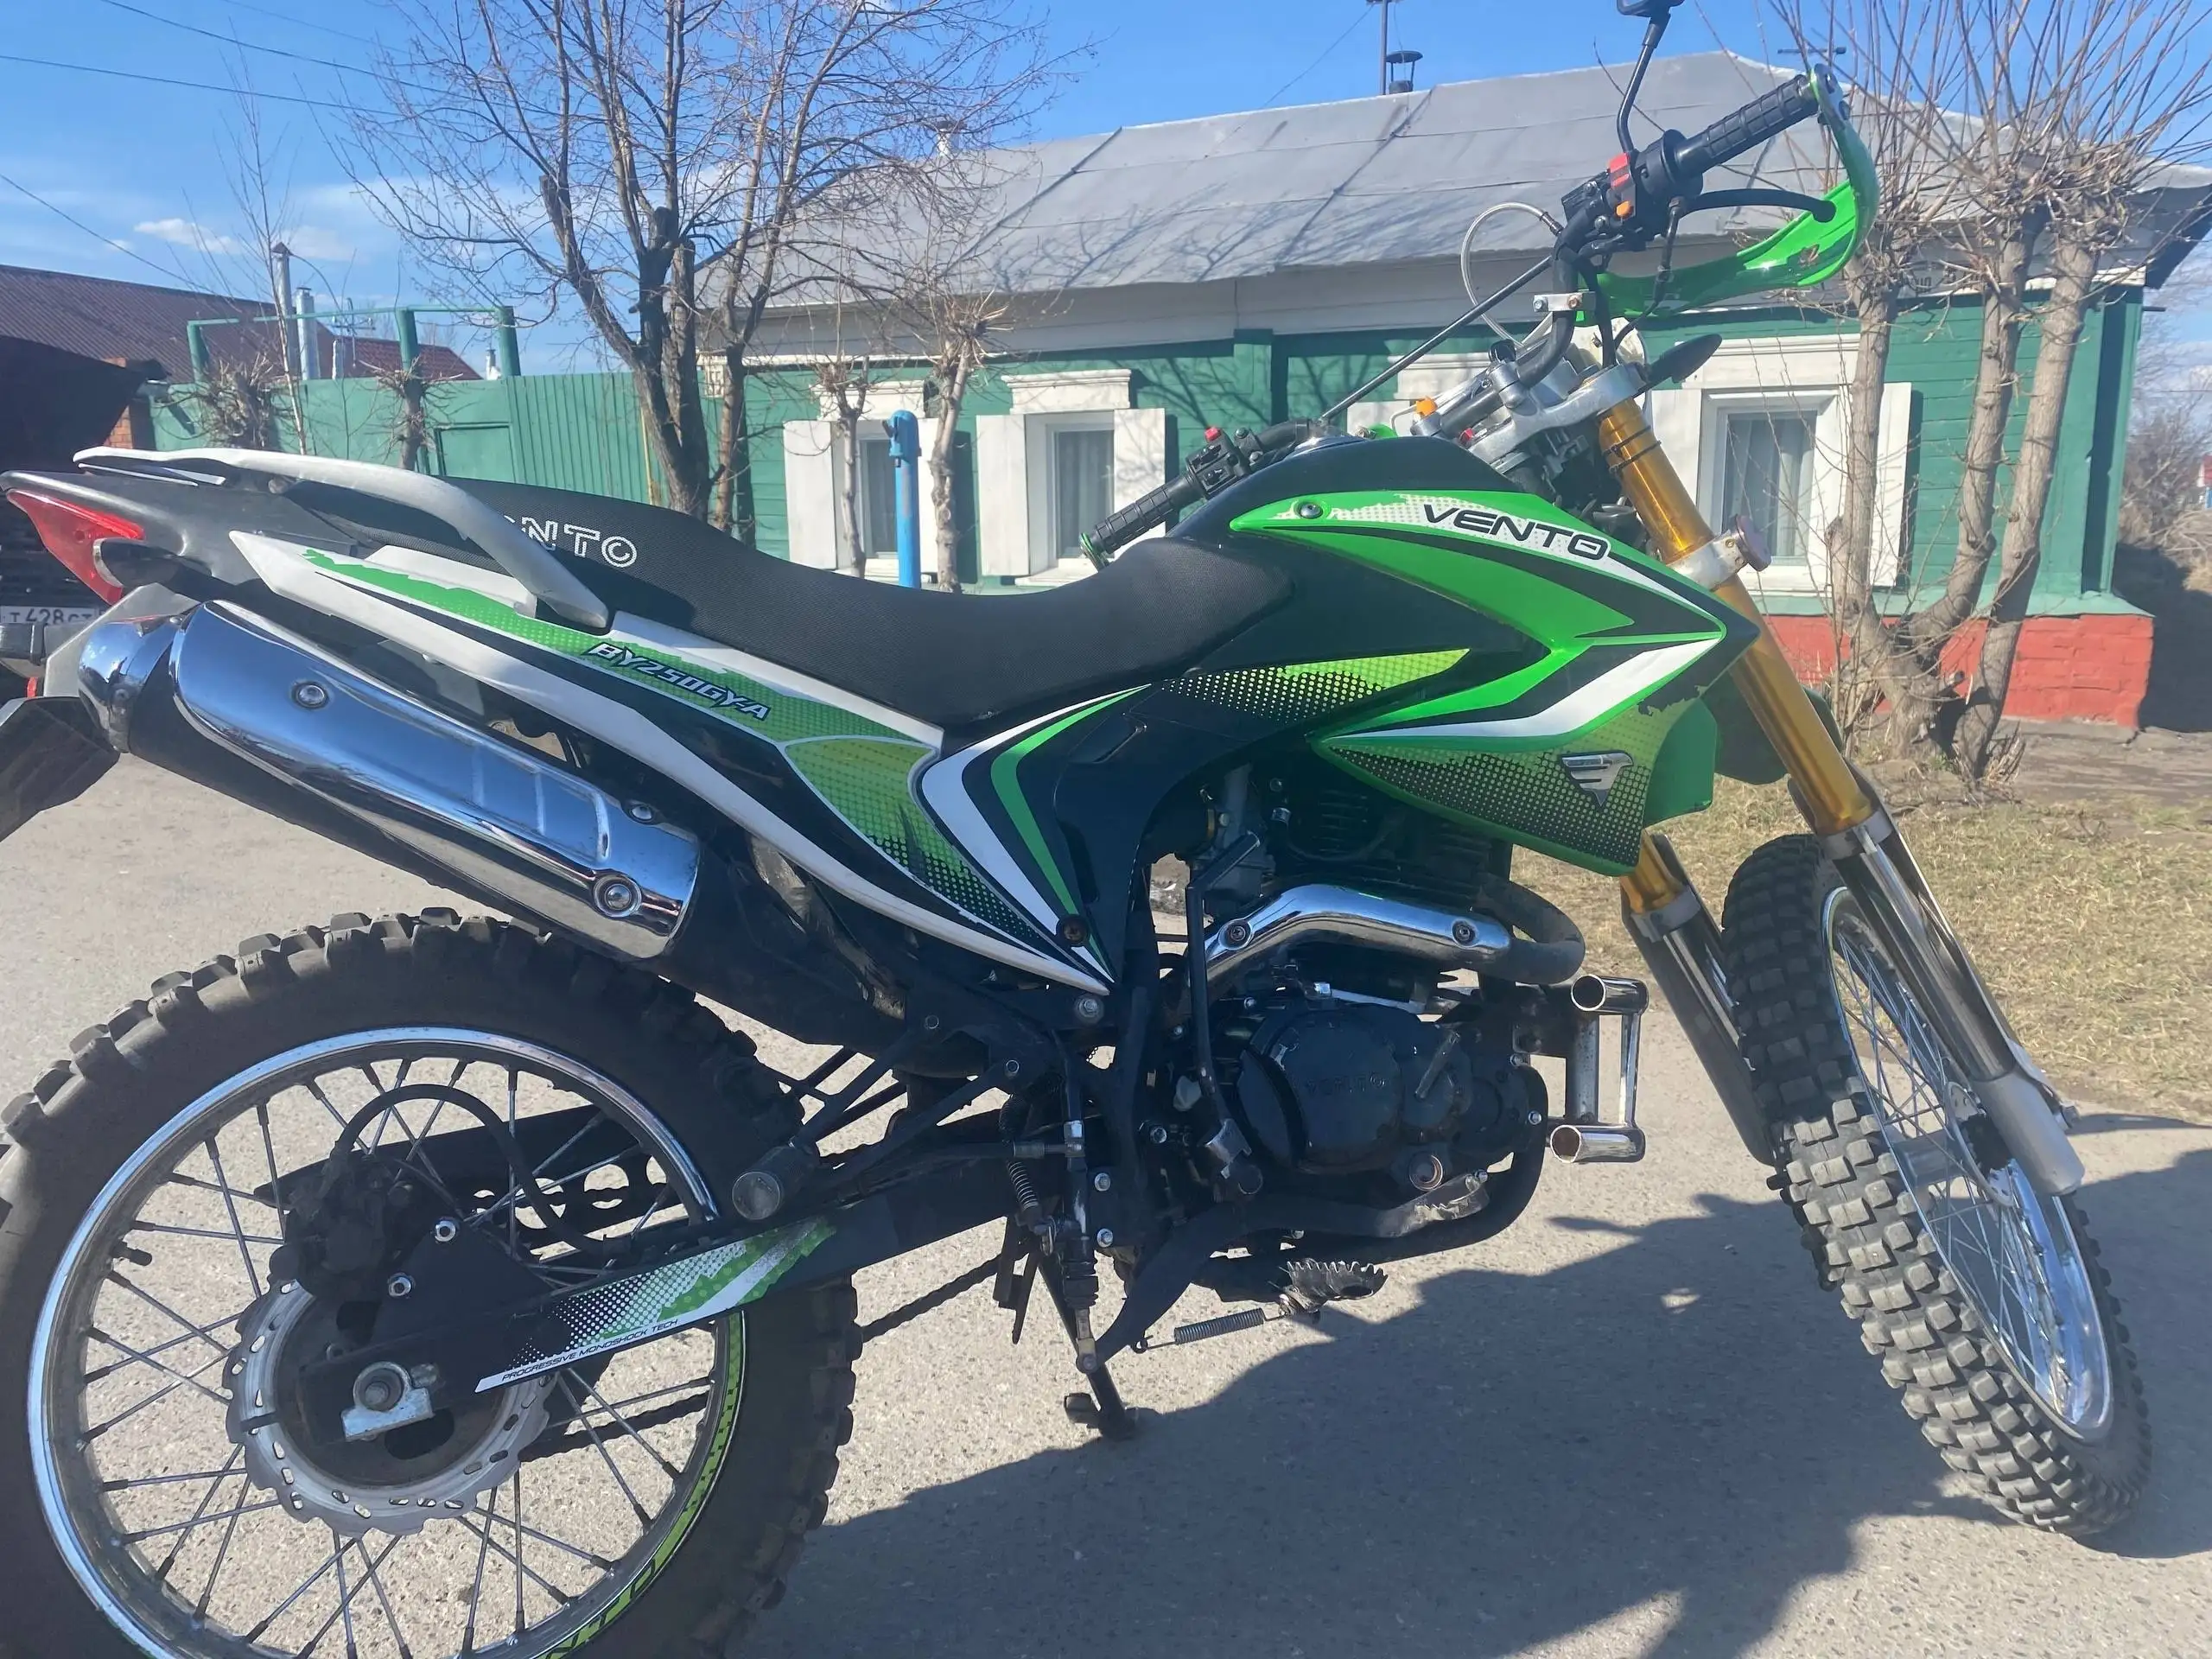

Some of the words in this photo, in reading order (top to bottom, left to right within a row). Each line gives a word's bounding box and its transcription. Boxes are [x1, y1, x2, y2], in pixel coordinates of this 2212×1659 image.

[504, 515, 638, 568] NTO
[1424, 504, 1608, 561] VENTO
[582, 642, 770, 720] BY250GY-A
[501, 1351, 577, 1381] PROGRESSIVE
[579, 1328, 648, 1356] MONOSHOCK
[652, 1319, 678, 1333] TECH
